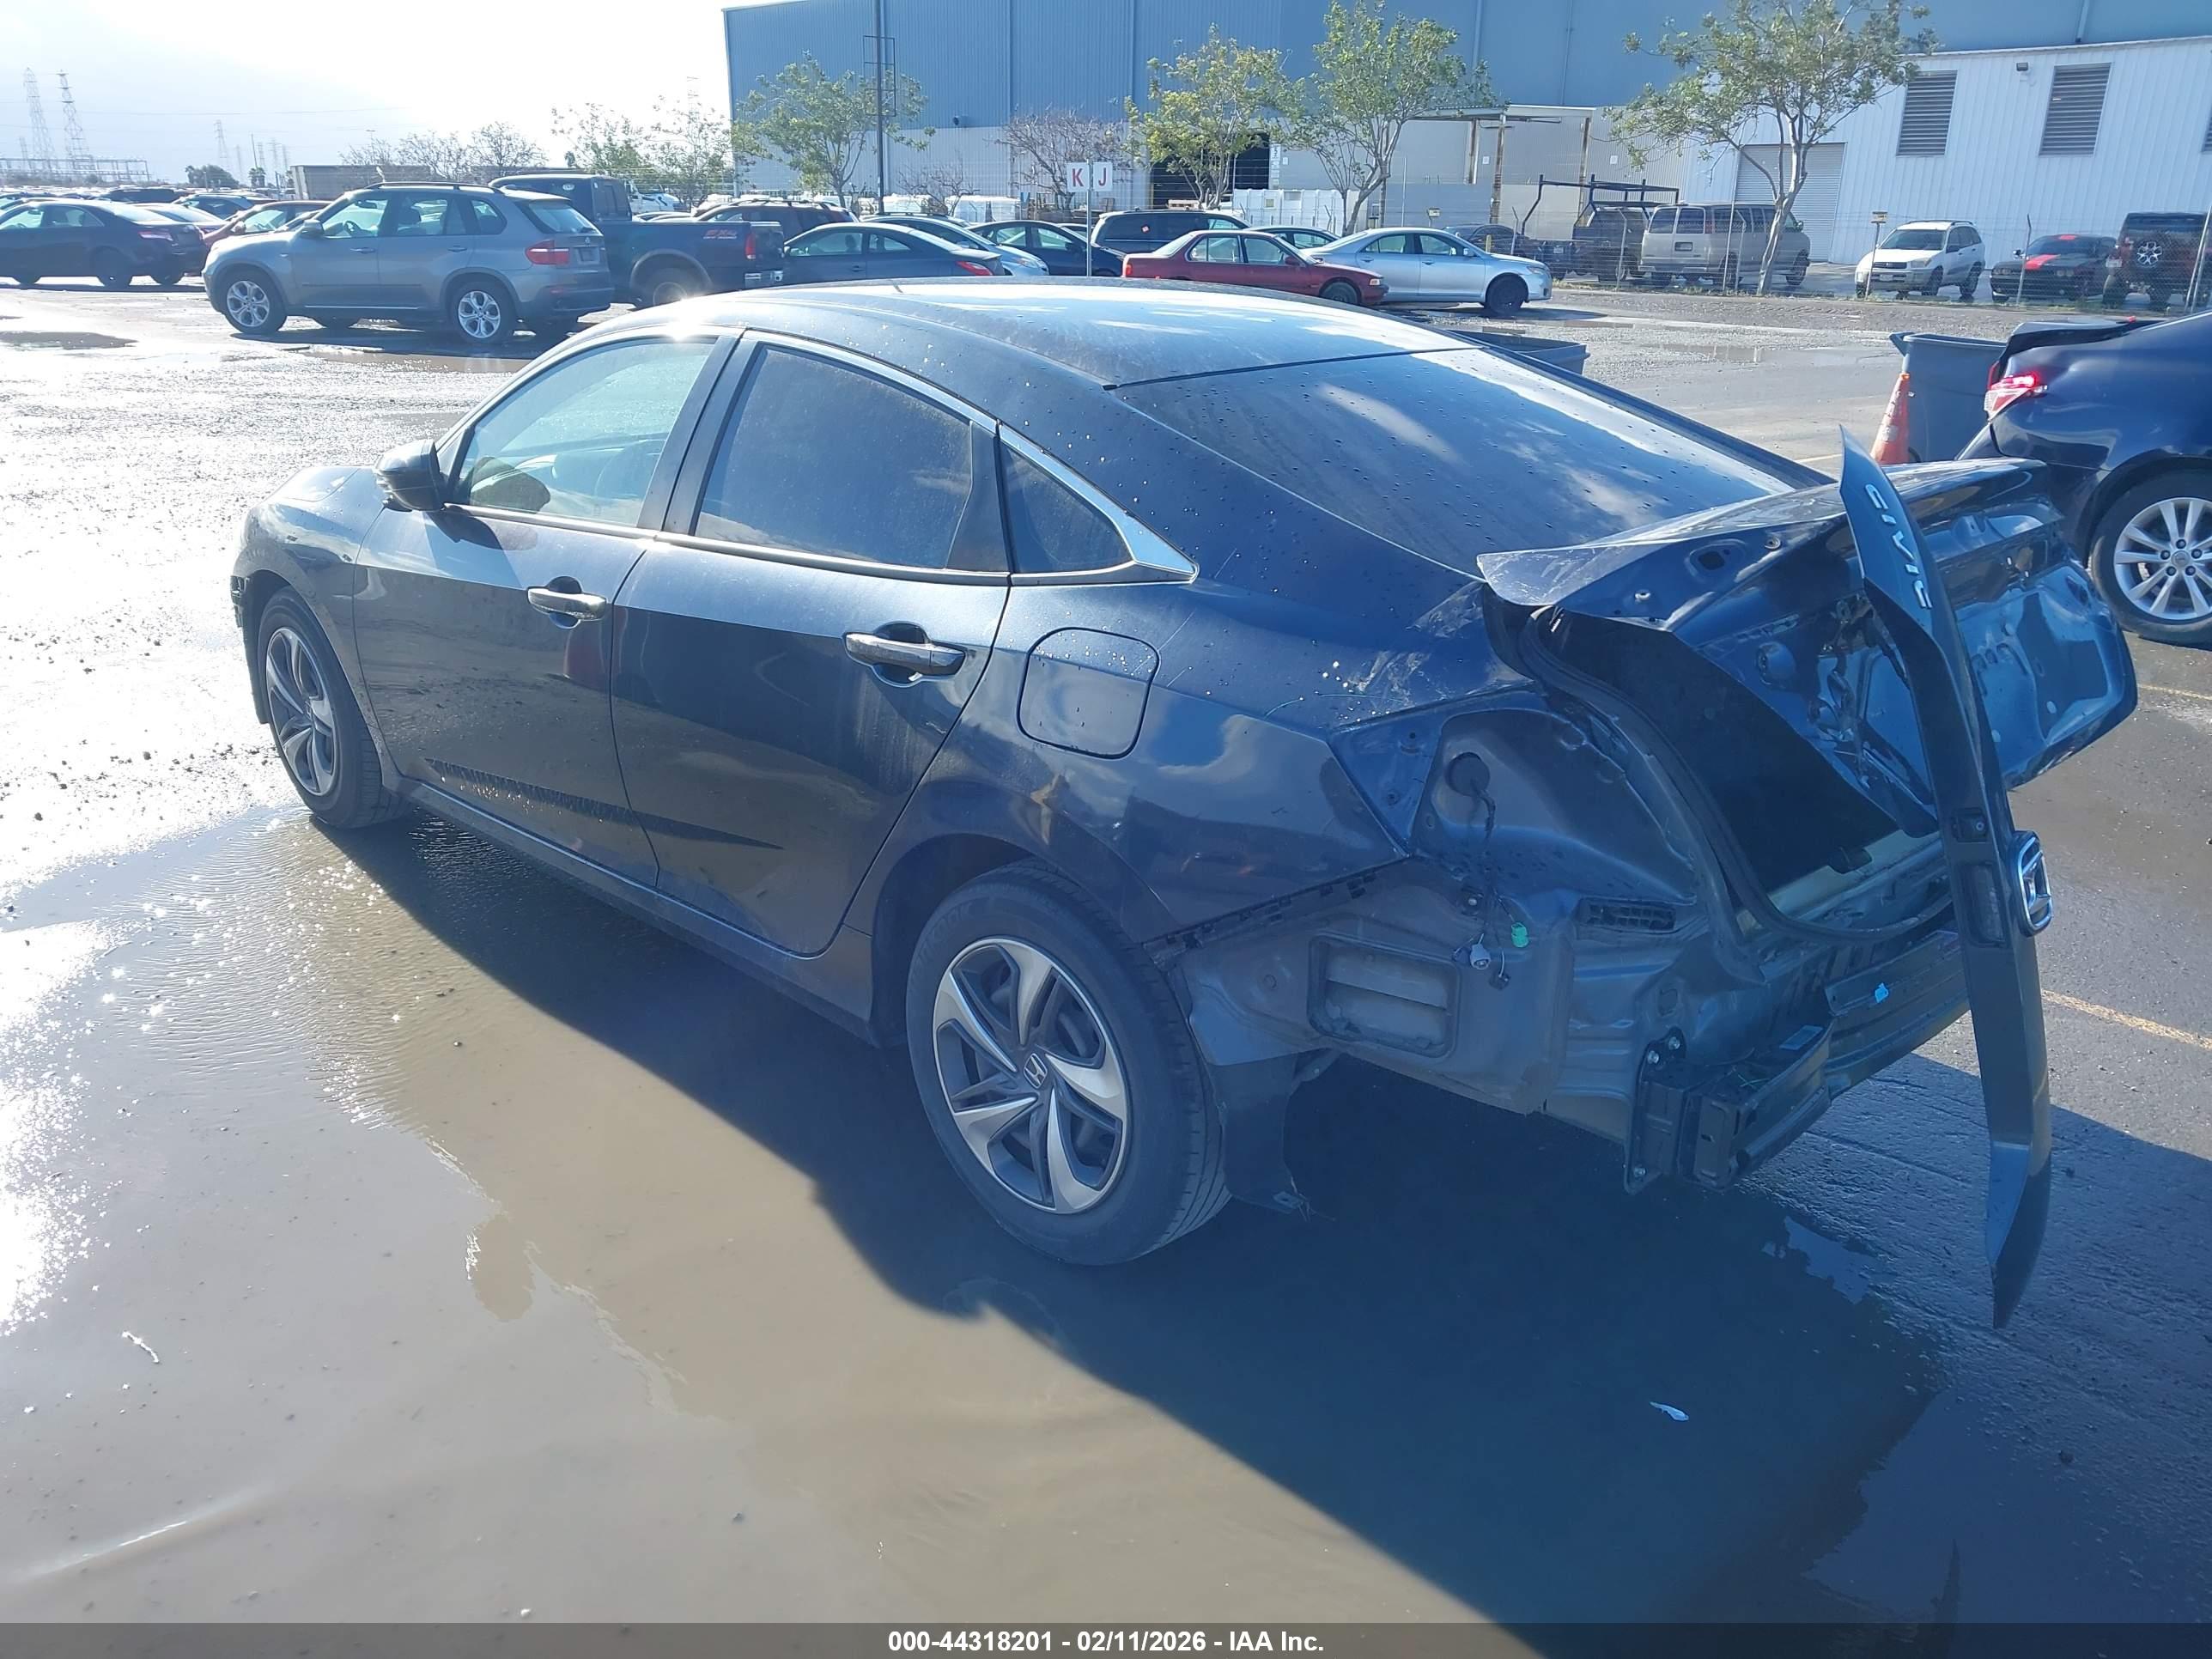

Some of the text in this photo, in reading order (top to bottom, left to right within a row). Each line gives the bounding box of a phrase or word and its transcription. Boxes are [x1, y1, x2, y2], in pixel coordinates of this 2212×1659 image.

[1072, 167, 1084, 187] K
[1097, 167, 1107, 186] J
[1864, 483, 1932, 609] CIVIC
